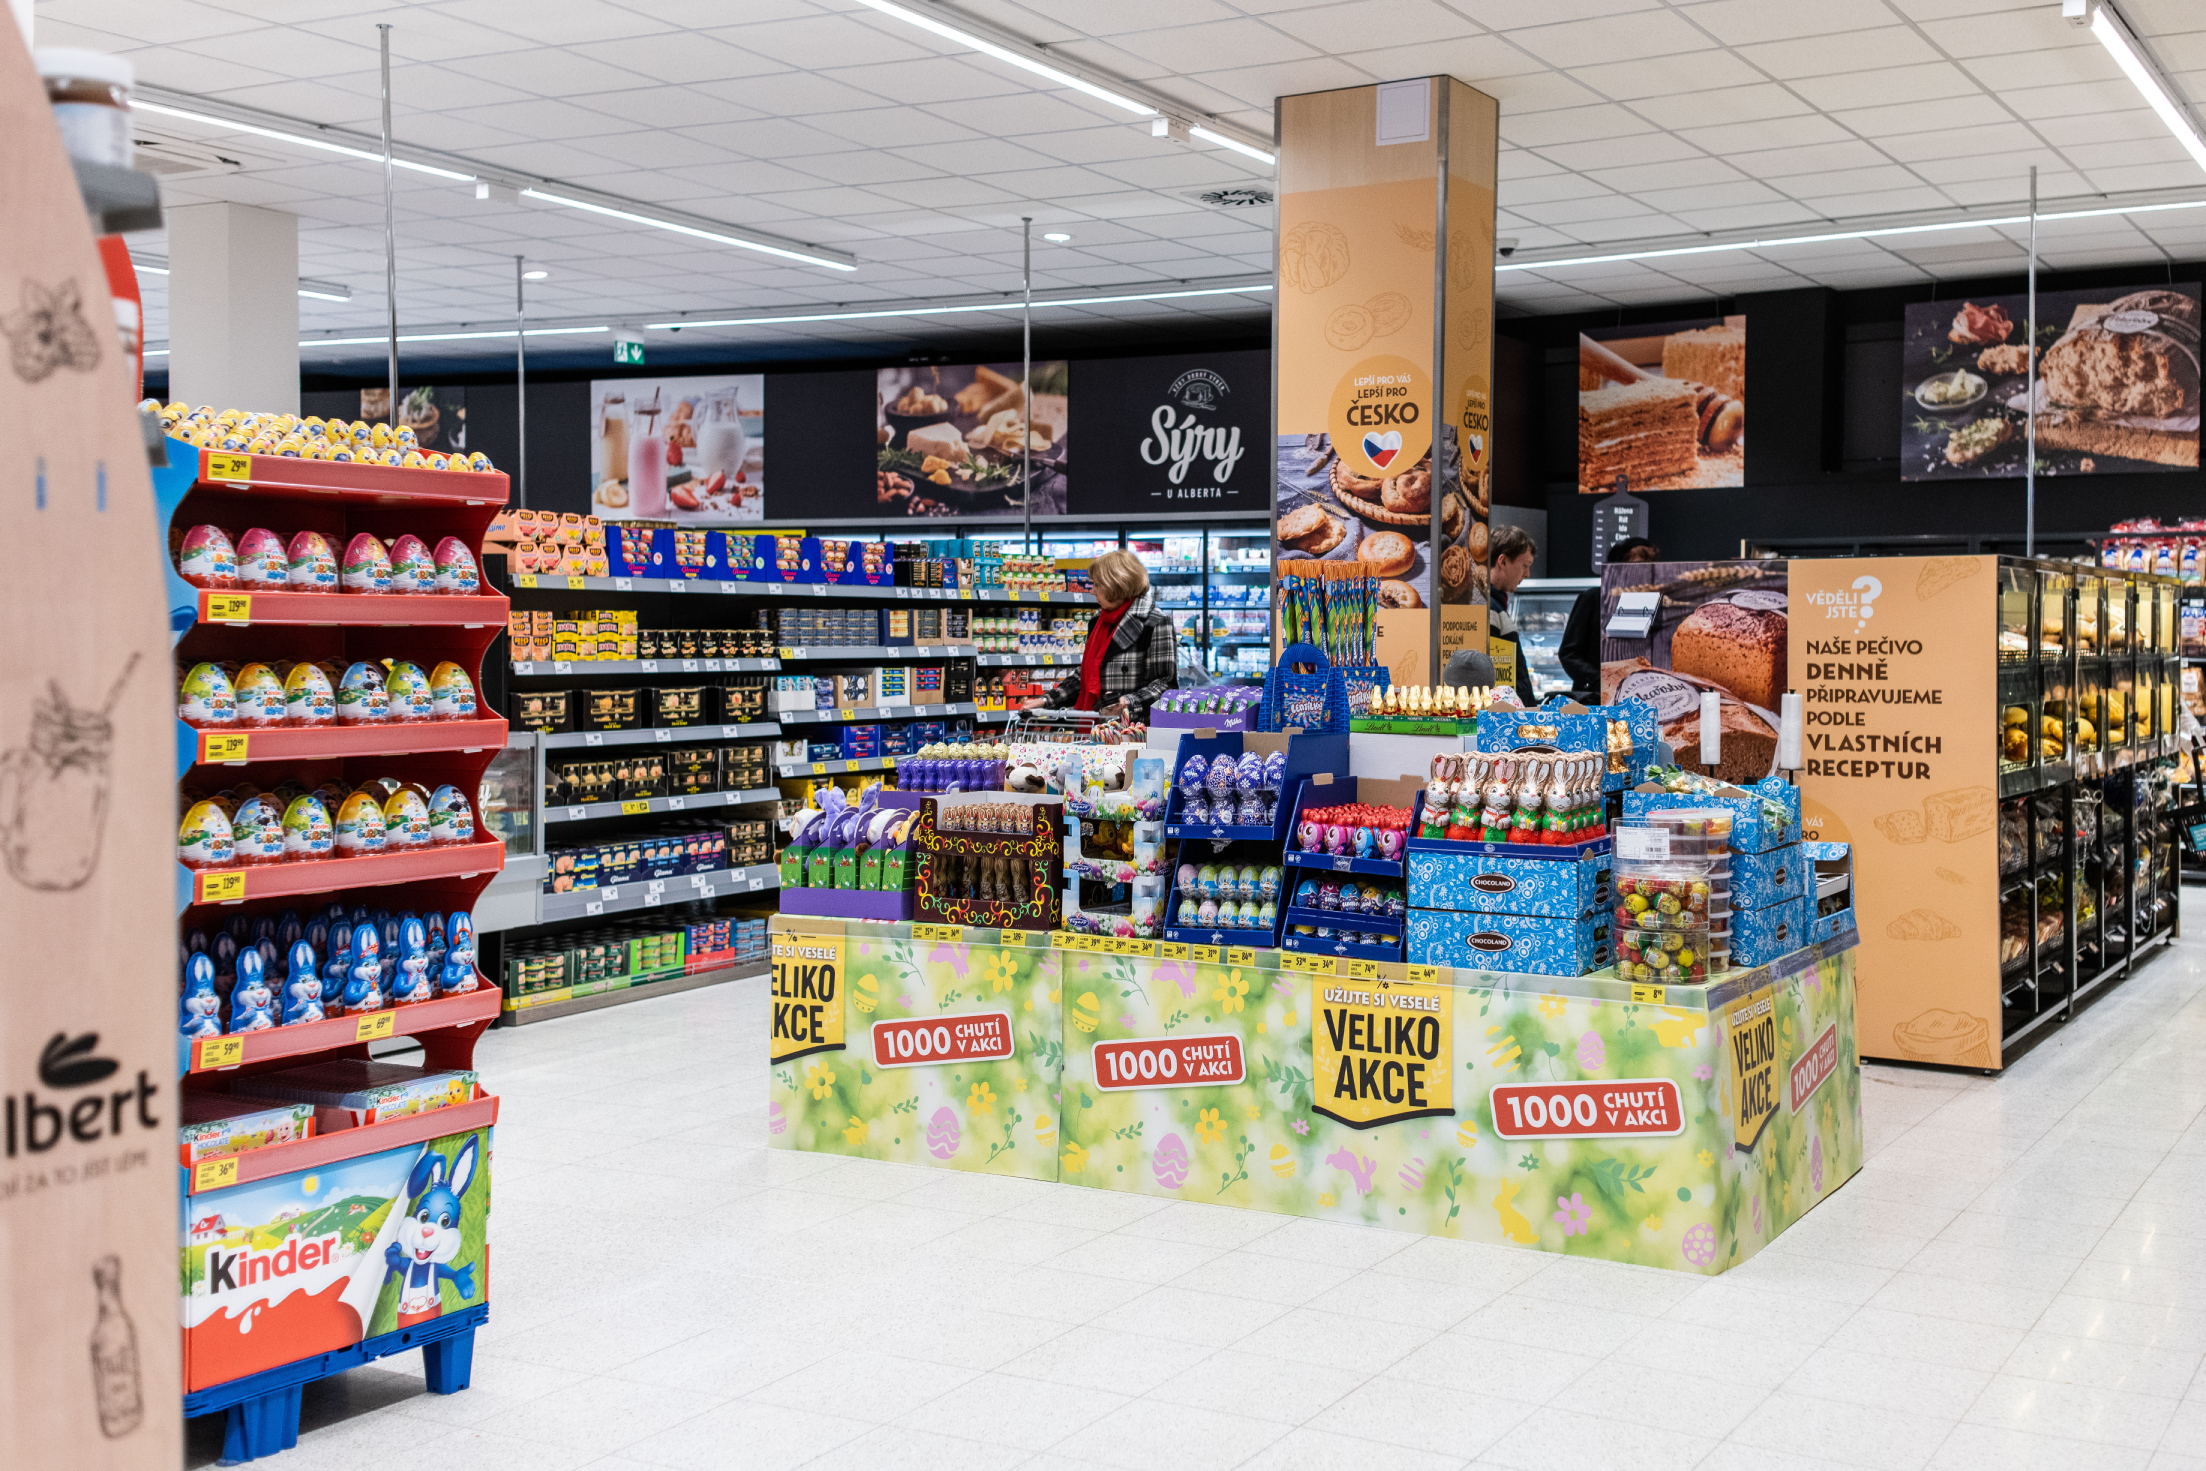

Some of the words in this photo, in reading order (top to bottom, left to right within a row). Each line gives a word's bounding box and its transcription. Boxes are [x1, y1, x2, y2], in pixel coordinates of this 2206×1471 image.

[1354, 374, 1375, 387] LEPŠÍ
[1377, 376, 1394, 385] PRO
[1396, 372, 1411, 383] VÁS
[1357, 386, 1384, 399] LEPŠÍ
[1386, 386, 1407, 397] PRO
[1346, 399, 1419, 426] ČESKO
[1463, 406, 1489, 431] ČESKO
[1140, 404, 1245, 484] Sýry
[1167, 489, 1173, 499] U
[1177, 488, 1221, 498] ALBERTA
[1806, 589, 1858, 605] VĚDĚLI
[1825, 606, 1857, 619] JSTE
[1443, 622, 1477, 632] PODPORUJEME
[1442, 633, 1464, 645] LOKÁLNÍ
[1806, 636, 1851, 655] NAŠE
[1856, 636, 1923, 655] PEČIVO
[1806, 658, 1888, 680] DENNĚ
[1806, 684, 1942, 704] PŘIPRAVUJEME
[1224, 718, 1243, 728] Milka
[1806, 711, 1865, 726] PODLE
[1365, 722, 1385, 731] Lindt
[1412, 724, 1434, 733] Lindt
[1806, 730, 1942, 754] VLASTNÍCH
[1806, 759, 1930, 780] RECEPTUR
[1805, 817, 1824, 828] VÁS
[654, 868, 674, 878] Giana
[696, 863, 715, 872] Giana
[610, 874, 631, 884] Giana
[1474, 879, 1511, 887] CHOCOLAND
[1471, 937, 1507, 946] CHOCOLAND
[786, 947, 795, 958] SI
[798, 945, 836, 960] VESELÉ
[1324, 987, 1370, 1006] UŽIJTE
[1373, 993, 1385, 1007] SI
[1390, 994, 1440, 1012] VESELÉ
[1753, 995, 1771, 1017] VESELÉ
[883, 1026, 951, 1059] 1000
[955, 1018, 1000, 1038] CHUTÍ
[1323, 1008, 1440, 1061] VELIKO
[956, 1039, 968, 1053] V
[970, 1036, 1002, 1053] AKCI
[1733, 1016, 1775, 1078] VELIKO
[1105, 1048, 1178, 1082] 1000
[1182, 1040, 1231, 1062] CHUTÍ
[1184, 1063, 1195, 1077] V
[1198, 1060, 1233, 1077] AKCI
[1794, 1052, 1818, 1102] 1000
[1819, 1029, 1834, 1059] CHUTÍ
[1823, 1049, 1835, 1071] AKCI
[1334, 1054, 1428, 1108] AKCE
[376, 1094, 400, 1106] Kinder
[1741, 1065, 1772, 1127] AKCE
[1506, 1093, 1598, 1128] 1000
[1603, 1087, 1665, 1109] CHUTÍ
[1605, 1110, 1618, 1127] V
[1624, 1109, 1668, 1125] AKCI
[193, 1130, 221, 1142] Kinder
[210, 1236, 336, 1295] Kinder
